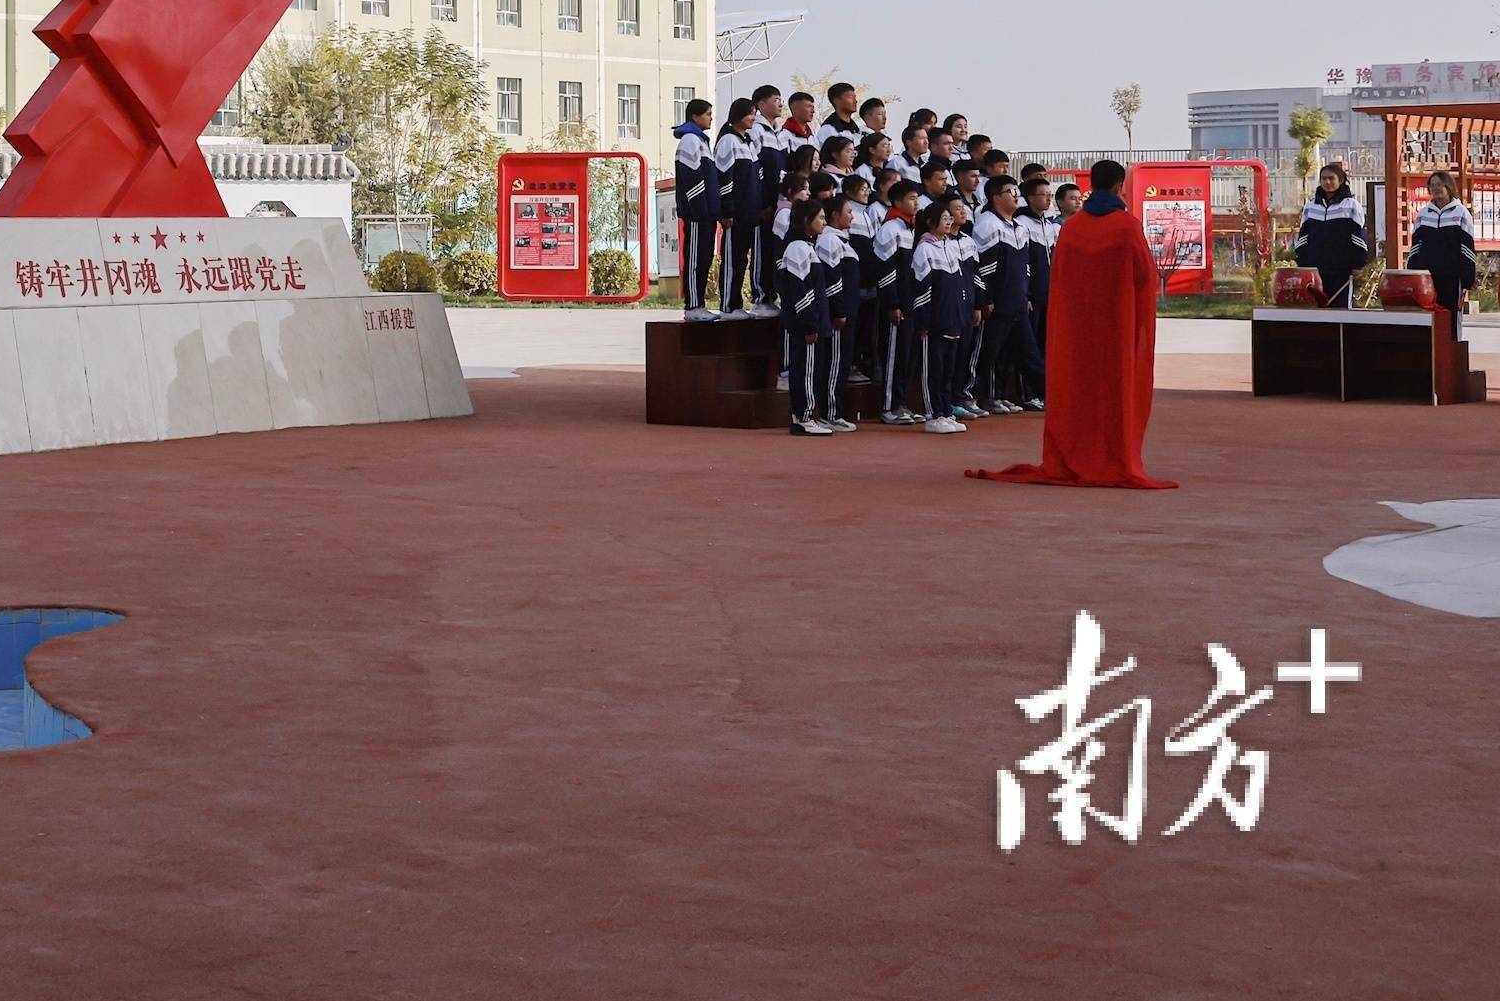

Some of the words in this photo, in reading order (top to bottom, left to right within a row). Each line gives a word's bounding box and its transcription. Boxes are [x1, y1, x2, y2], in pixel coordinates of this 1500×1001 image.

[15, 258, 162, 298] 铸牢井冈魂
[175, 255, 307, 294] 永远跟党走
[364, 307, 416, 331] 江西援建
